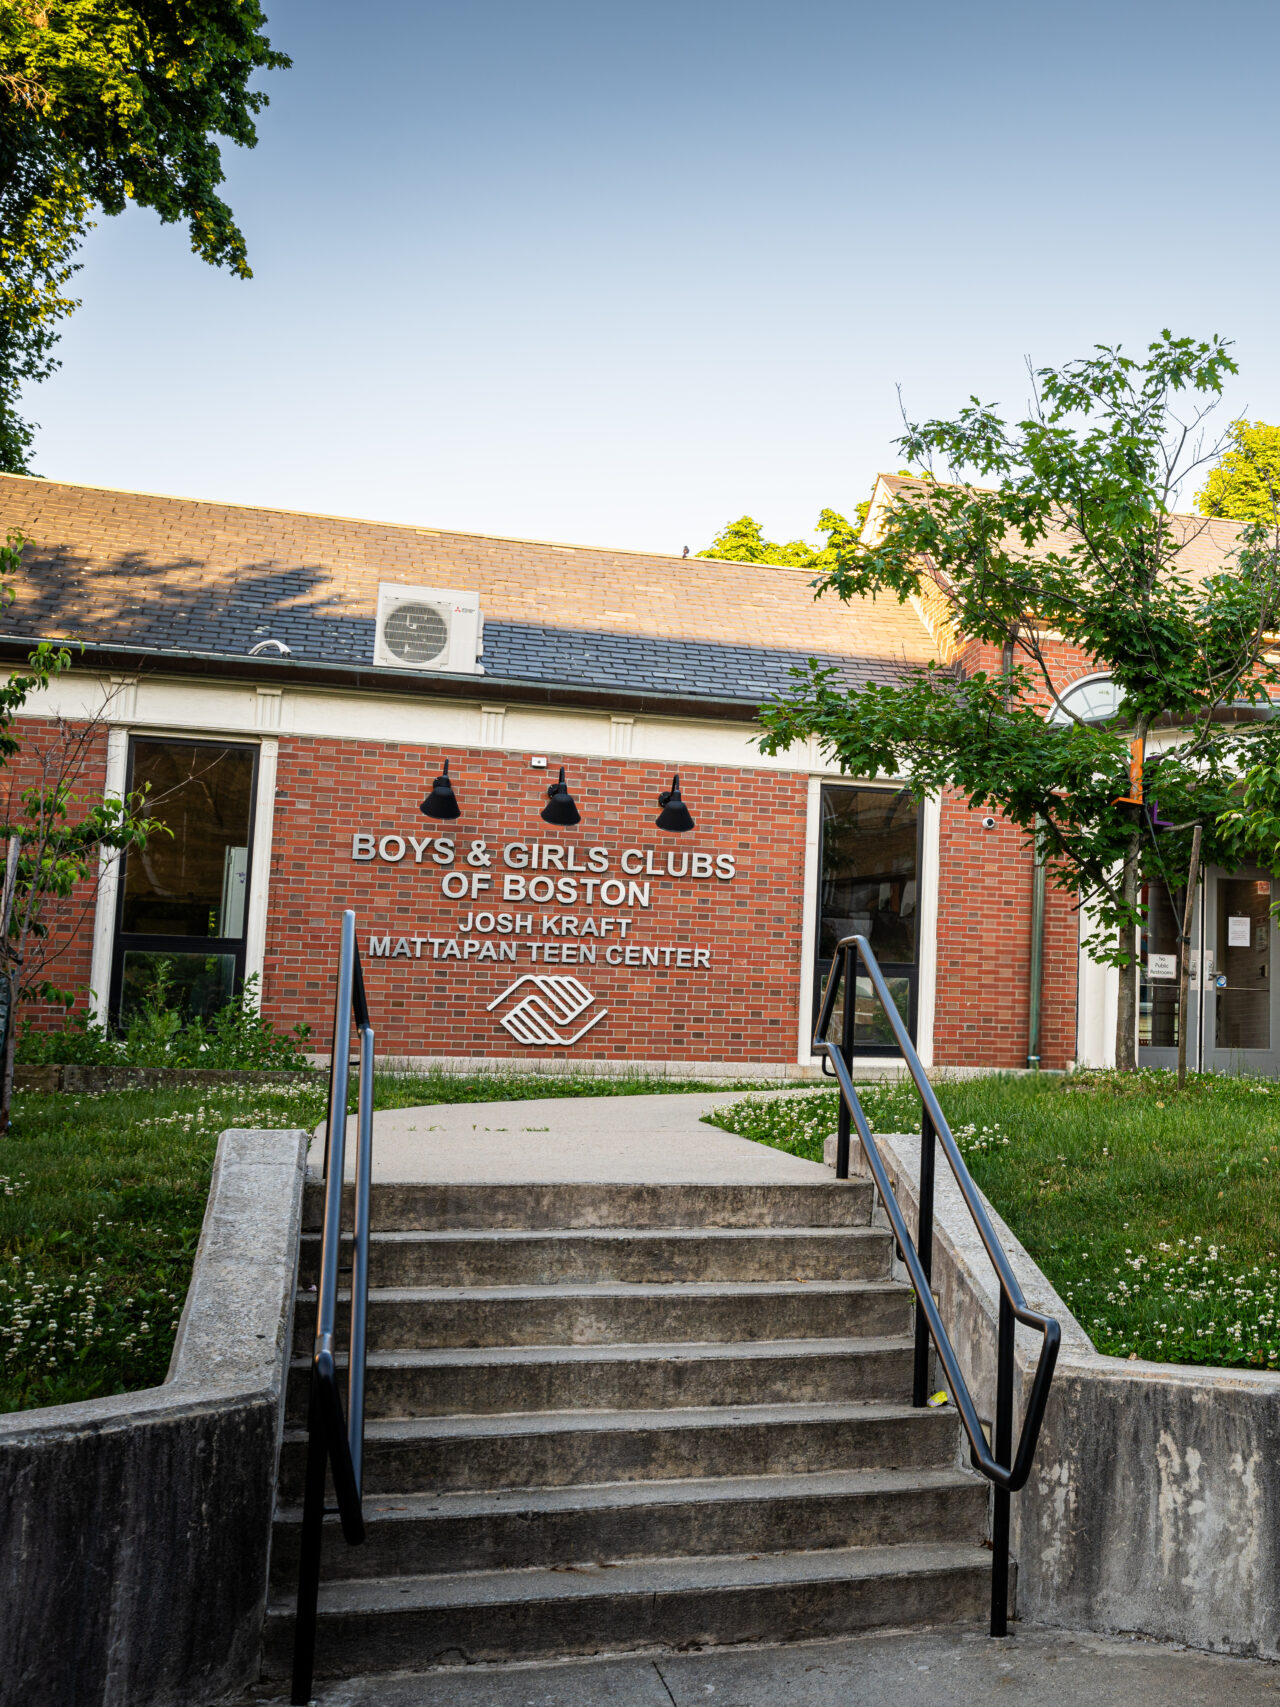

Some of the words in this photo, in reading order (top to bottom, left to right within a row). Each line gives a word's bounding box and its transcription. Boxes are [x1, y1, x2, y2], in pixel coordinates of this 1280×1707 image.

[352, 833, 455, 865] BOYS
[467, 839, 492, 867] &
[503, 842, 609, 874] GIRLS
[620, 848, 737, 880] CLUBS
[441, 872, 492, 899] OF
[503, 874, 650, 907] BOSTON
[458, 911, 533, 935] JOSH
[542, 915, 633, 939] KRAFT
[368, 935, 517, 962] MATTAPAN
[526, 941, 597, 964] TEEN
[605, 944, 711, 969] CENTER
